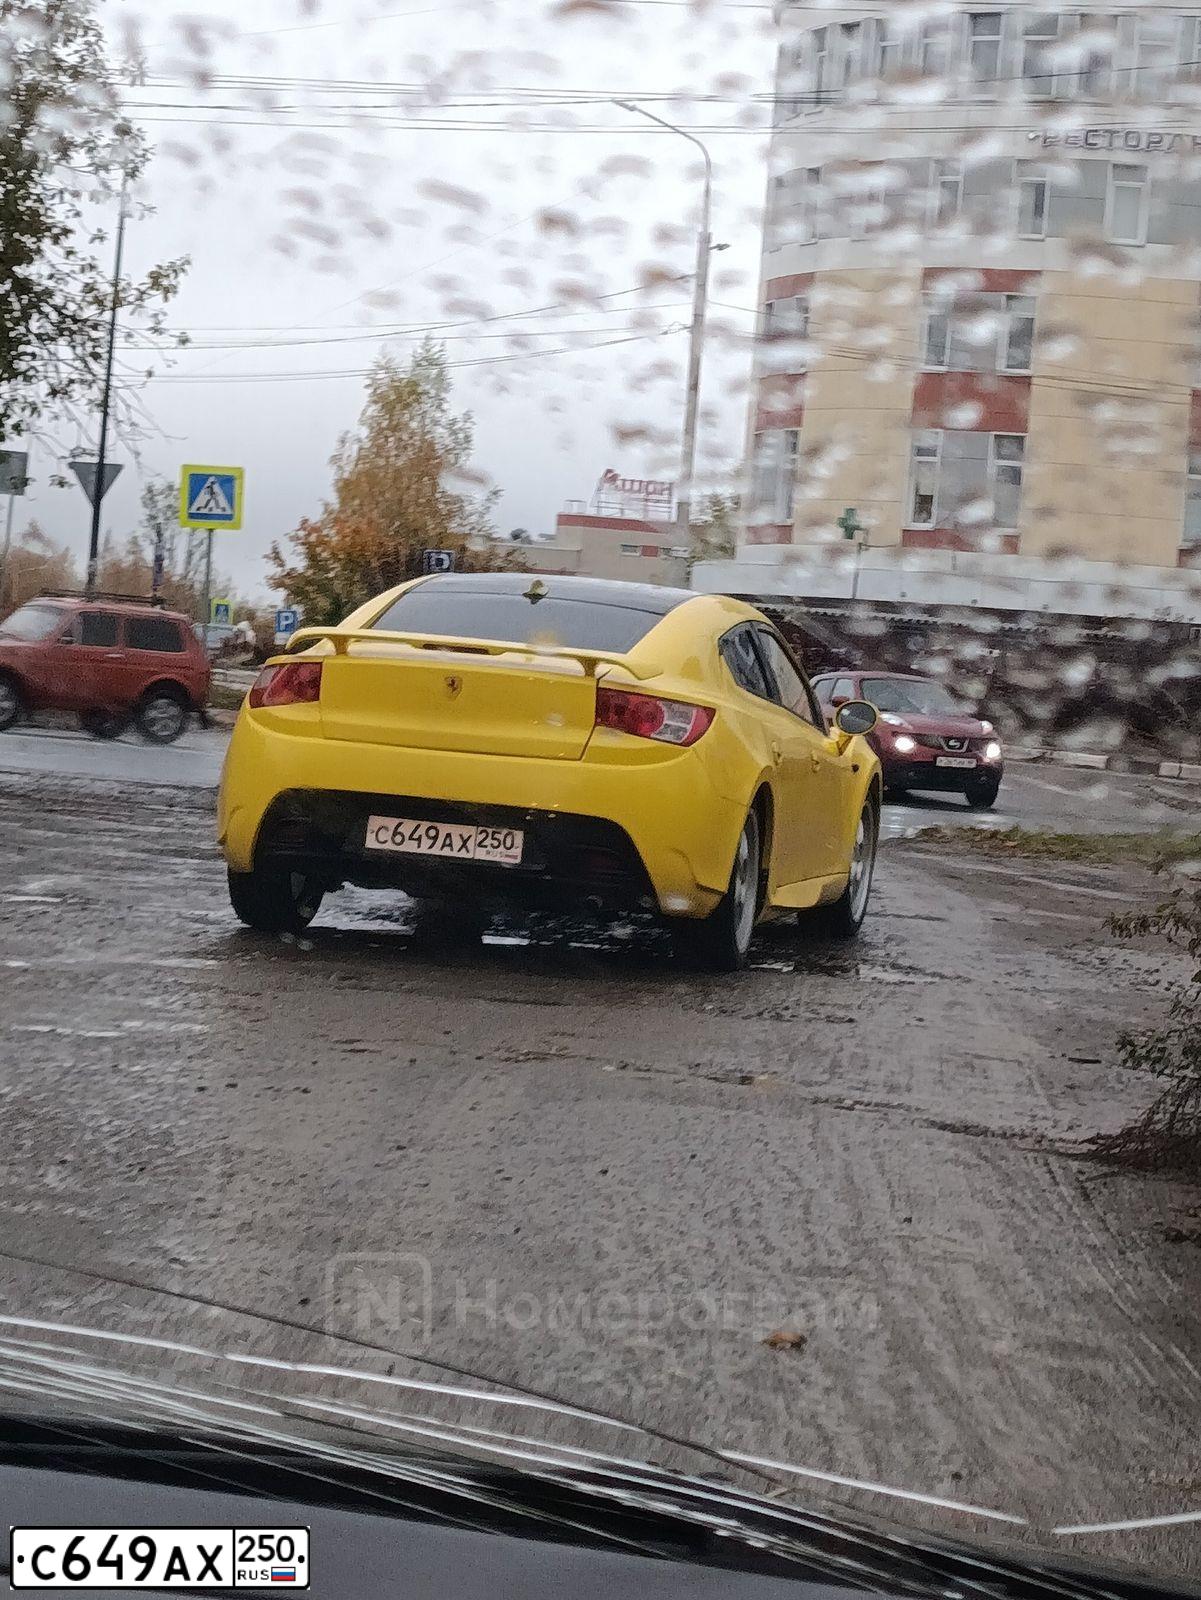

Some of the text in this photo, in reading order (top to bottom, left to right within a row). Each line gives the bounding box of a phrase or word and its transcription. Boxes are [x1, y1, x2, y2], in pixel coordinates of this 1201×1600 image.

[279, 611, 294, 631] P
[374, 822, 515, 854] С649АХ 250
